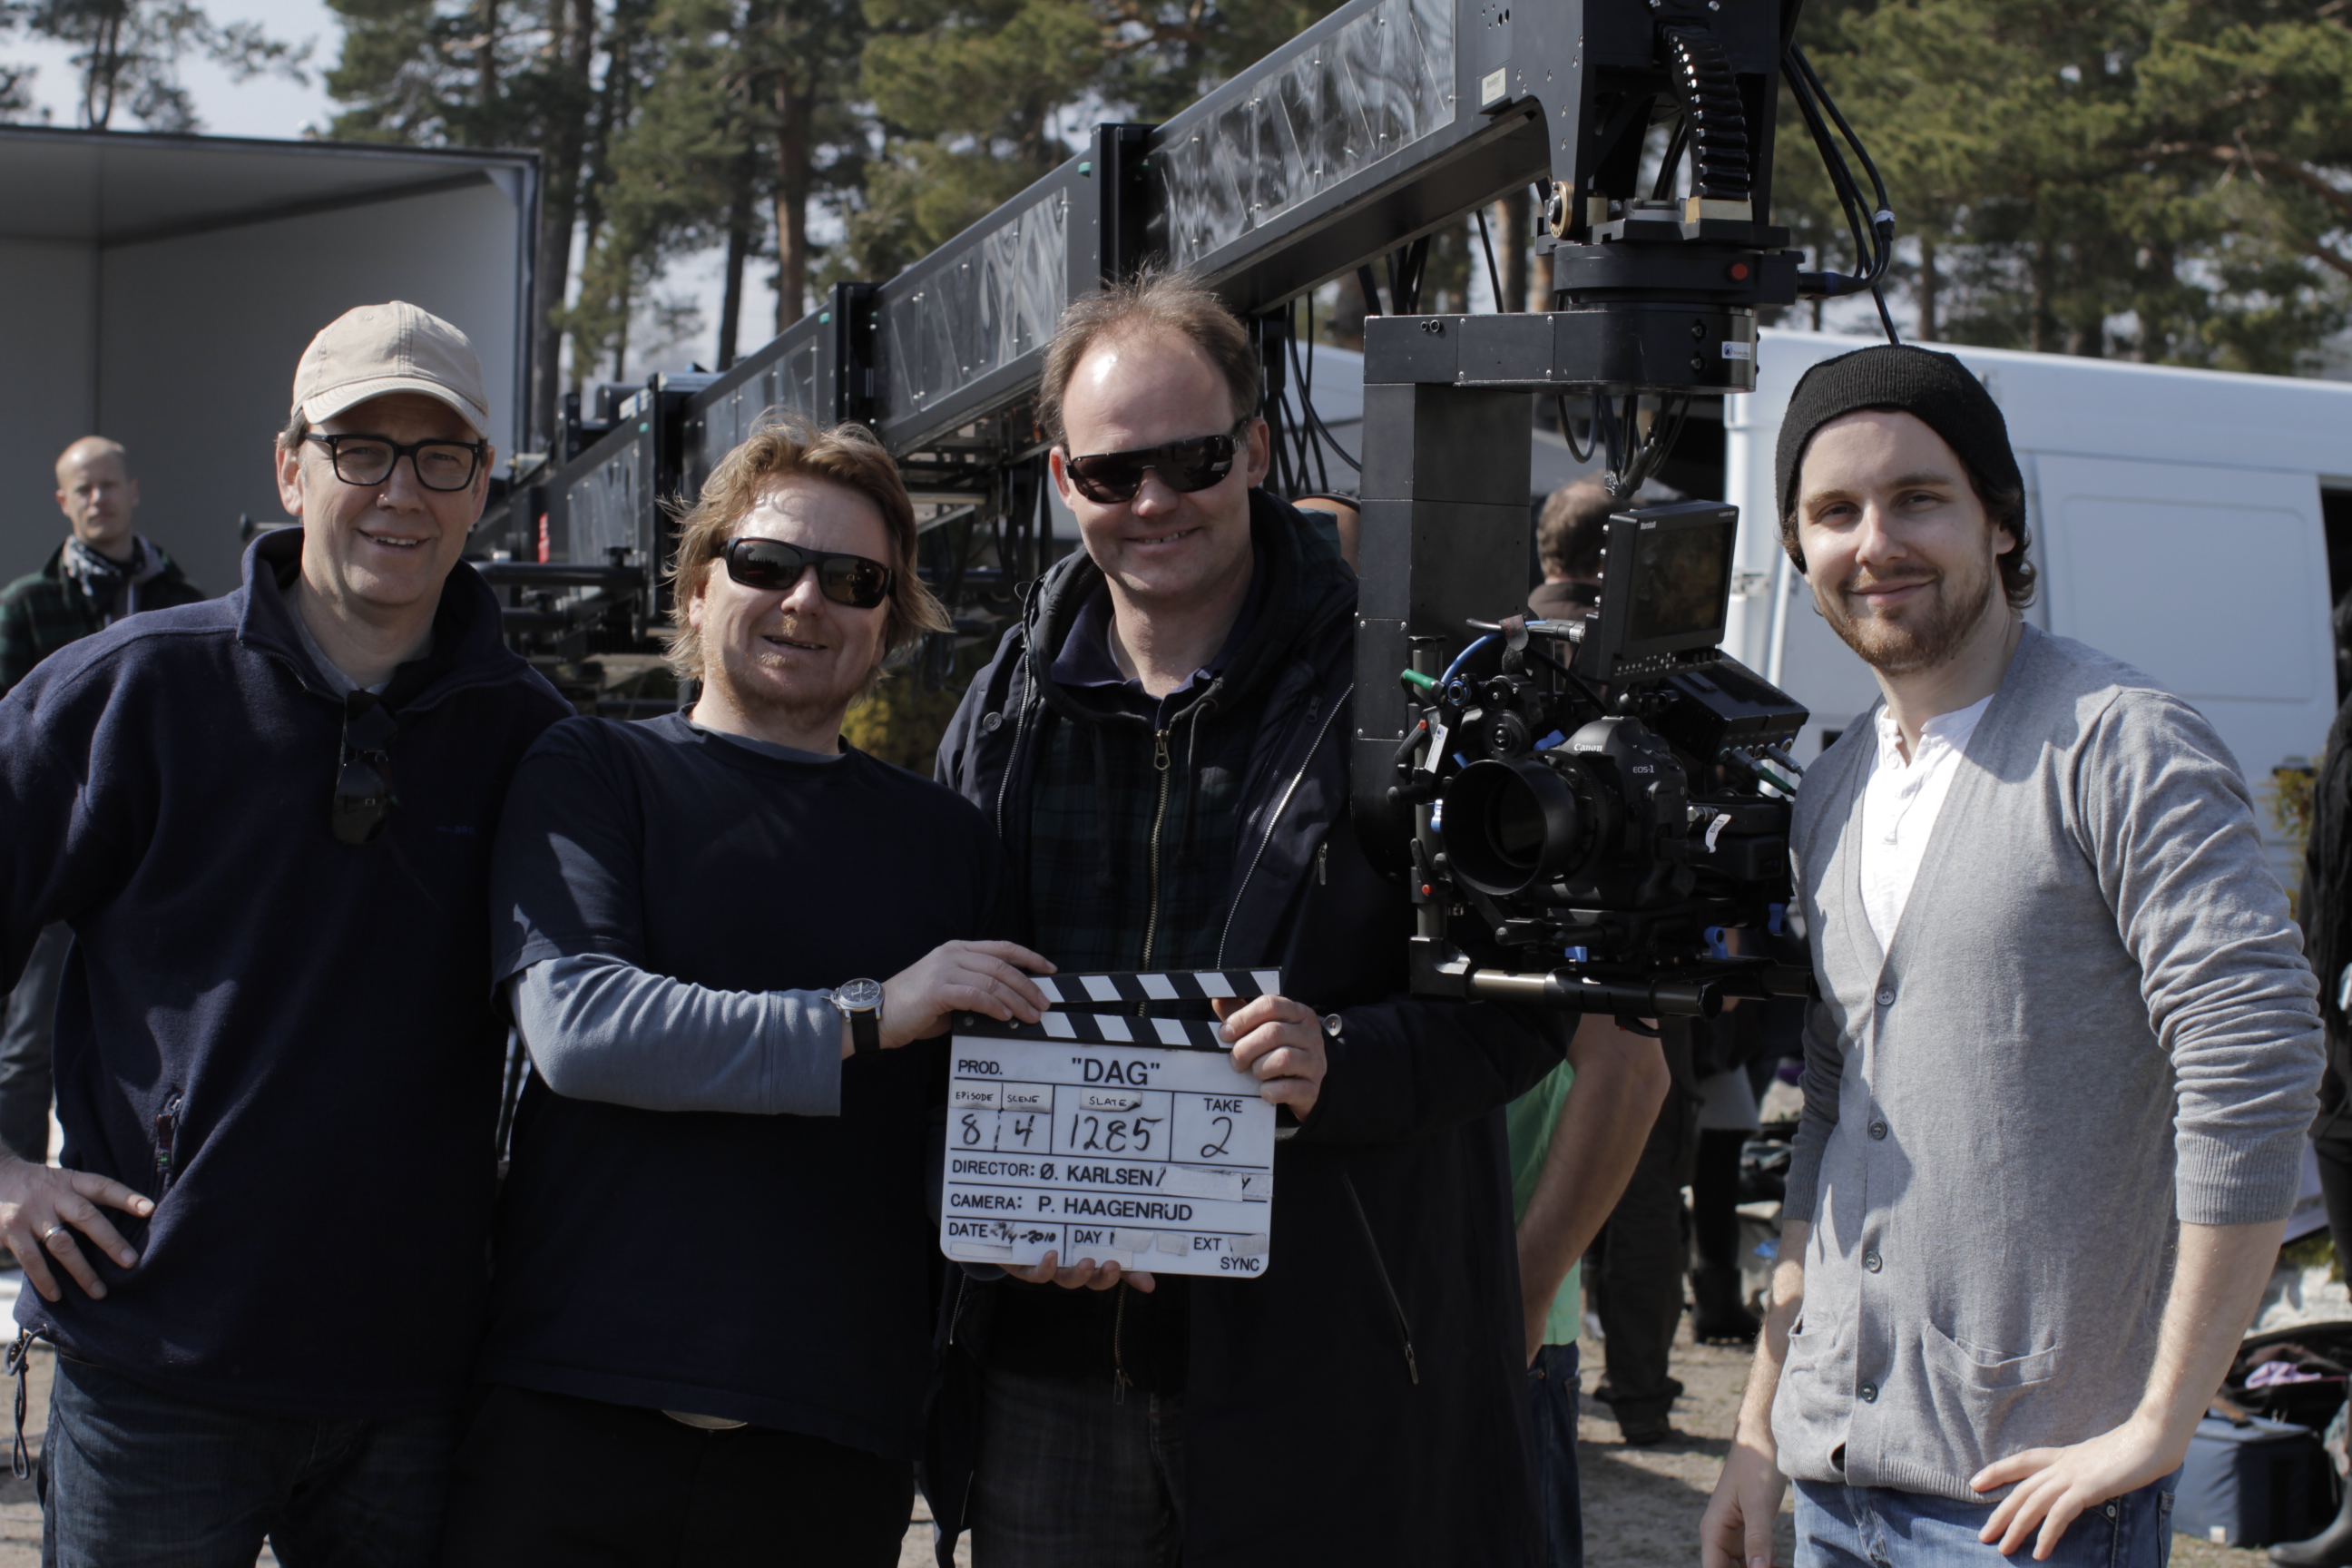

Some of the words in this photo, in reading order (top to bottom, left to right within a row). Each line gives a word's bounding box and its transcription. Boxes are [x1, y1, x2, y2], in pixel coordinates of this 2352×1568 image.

[1573, 742, 1602, 752] Canon
[958, 1059, 1003, 1075] PROD.
[1072, 1057, 1160, 1086] "DAG"
[1006, 1093, 1040, 1102] SCENE
[1089, 1096, 1127, 1107] SLATE
[1203, 1097, 1242, 1112] TAKE
[961, 1113, 981, 1145] 8
[1014, 1114, 1035, 1147] 4
[1070, 1113, 1166, 1152] 1285
[1200, 1116, 1232, 1159] 2
[952, 1159, 1035, 1177] DIRECTOR:
[950, 1193, 1023, 1210] CAMERA:
[1038, 1195, 1055, 1213] P.
[1074, 1230, 1102, 1244] DAY
[1193, 1237, 1222, 1251] EXT
[1220, 1256, 1259, 1271] SYNC
